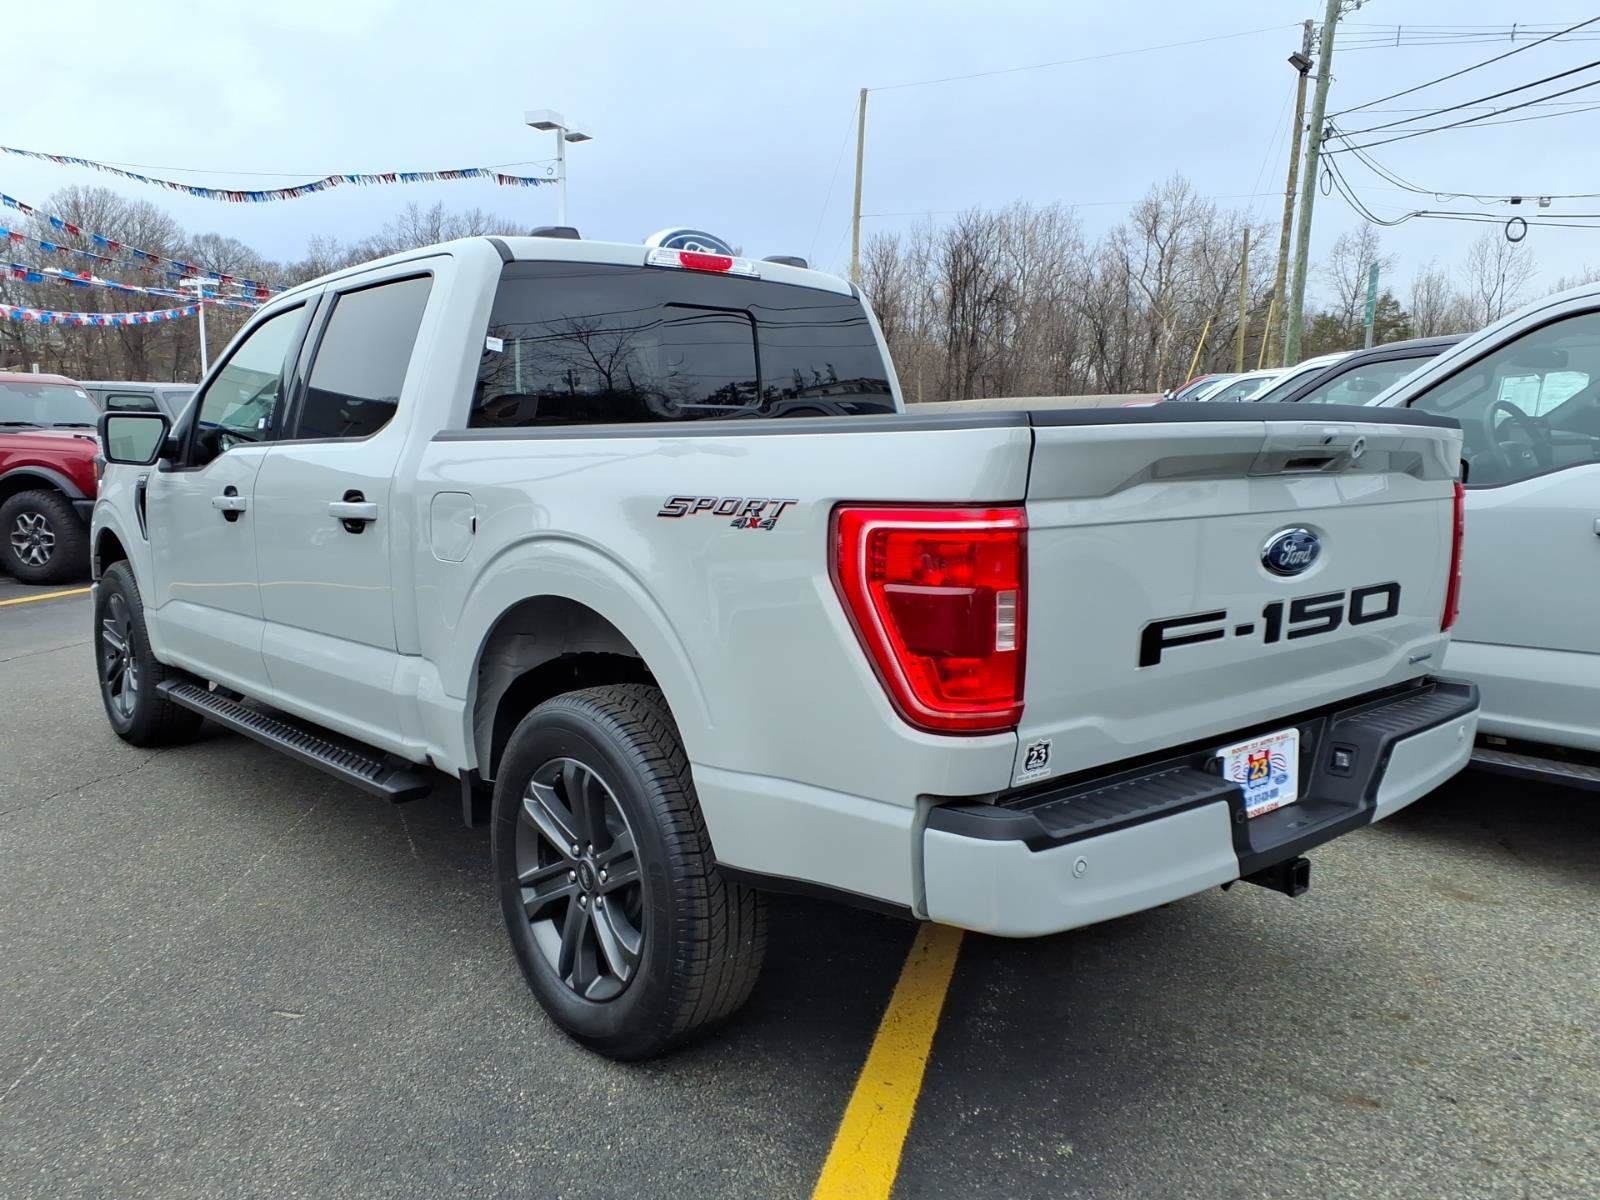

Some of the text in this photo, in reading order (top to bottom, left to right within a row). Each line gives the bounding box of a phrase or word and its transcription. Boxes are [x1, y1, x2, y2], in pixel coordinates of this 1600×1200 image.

[657, 495, 799, 517] SPORT
[1279, 539, 1313, 566] Ford
[1138, 582, 1401, 668] F-150
[1028, 748, 1046, 765] 23
[1250, 758, 1268, 780] 23
